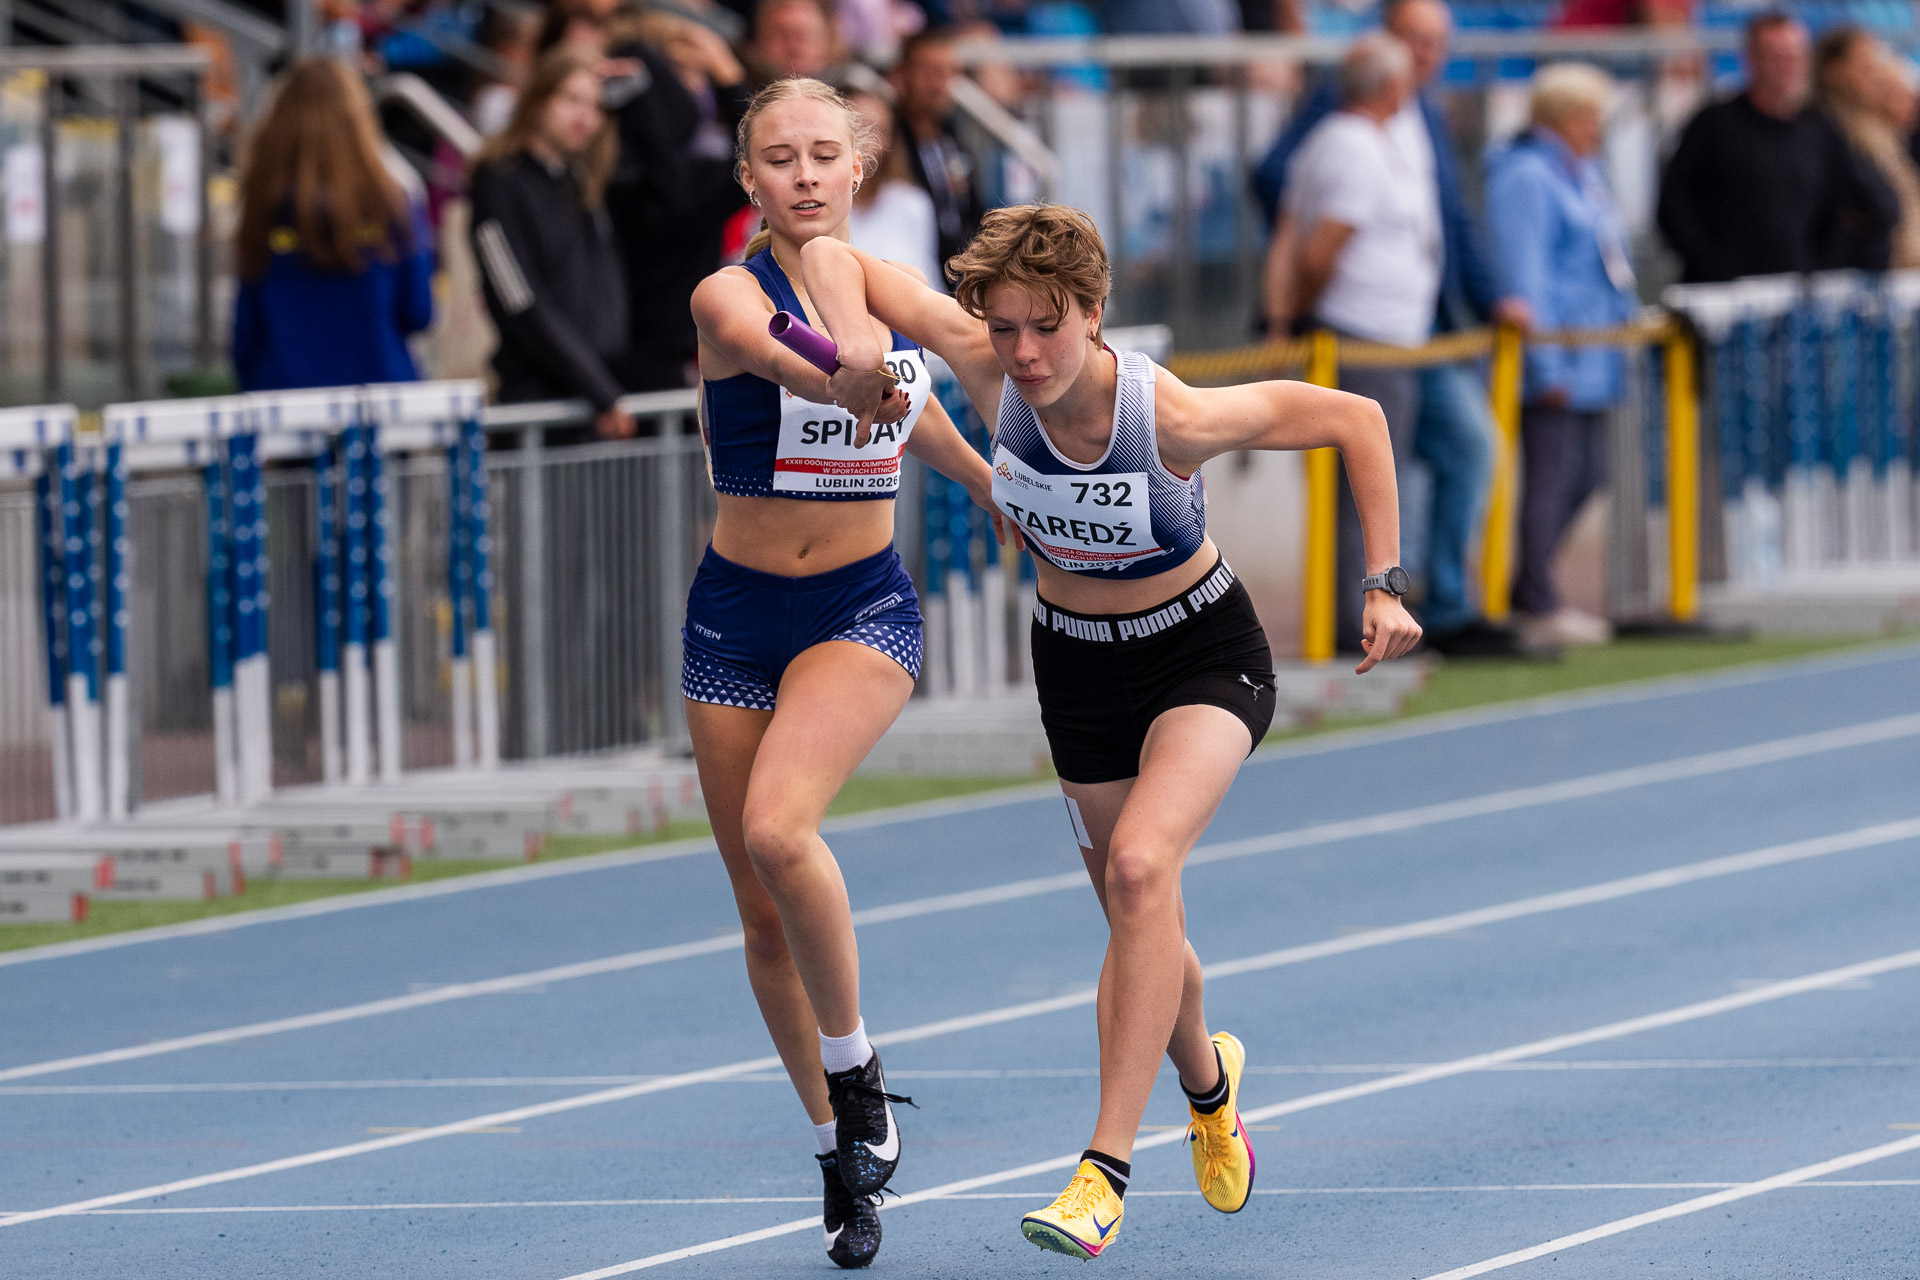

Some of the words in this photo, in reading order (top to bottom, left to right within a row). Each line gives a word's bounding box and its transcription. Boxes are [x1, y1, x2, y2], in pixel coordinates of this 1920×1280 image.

[885, 359, 916, 386] 30
[801, 409, 912, 445] SPIA
[804, 459, 860, 468] OGÓLNOPOLSKA
[861, 459, 897, 467] OLIMPIADA
[815, 478, 864, 488] LUBLIN
[867, 475, 898, 487] 2026
[1014, 470, 1053, 492] LUBELSKIE
[1014, 479, 1029, 490] 2026
[1070, 481, 1133, 507] 732
[1006, 501, 1137, 546] TARĘDŹ
[1052, 610, 1114, 642] PUMA
[1117, 601, 1188, 641] PUMA
[1187, 556, 1236, 613] PUM
